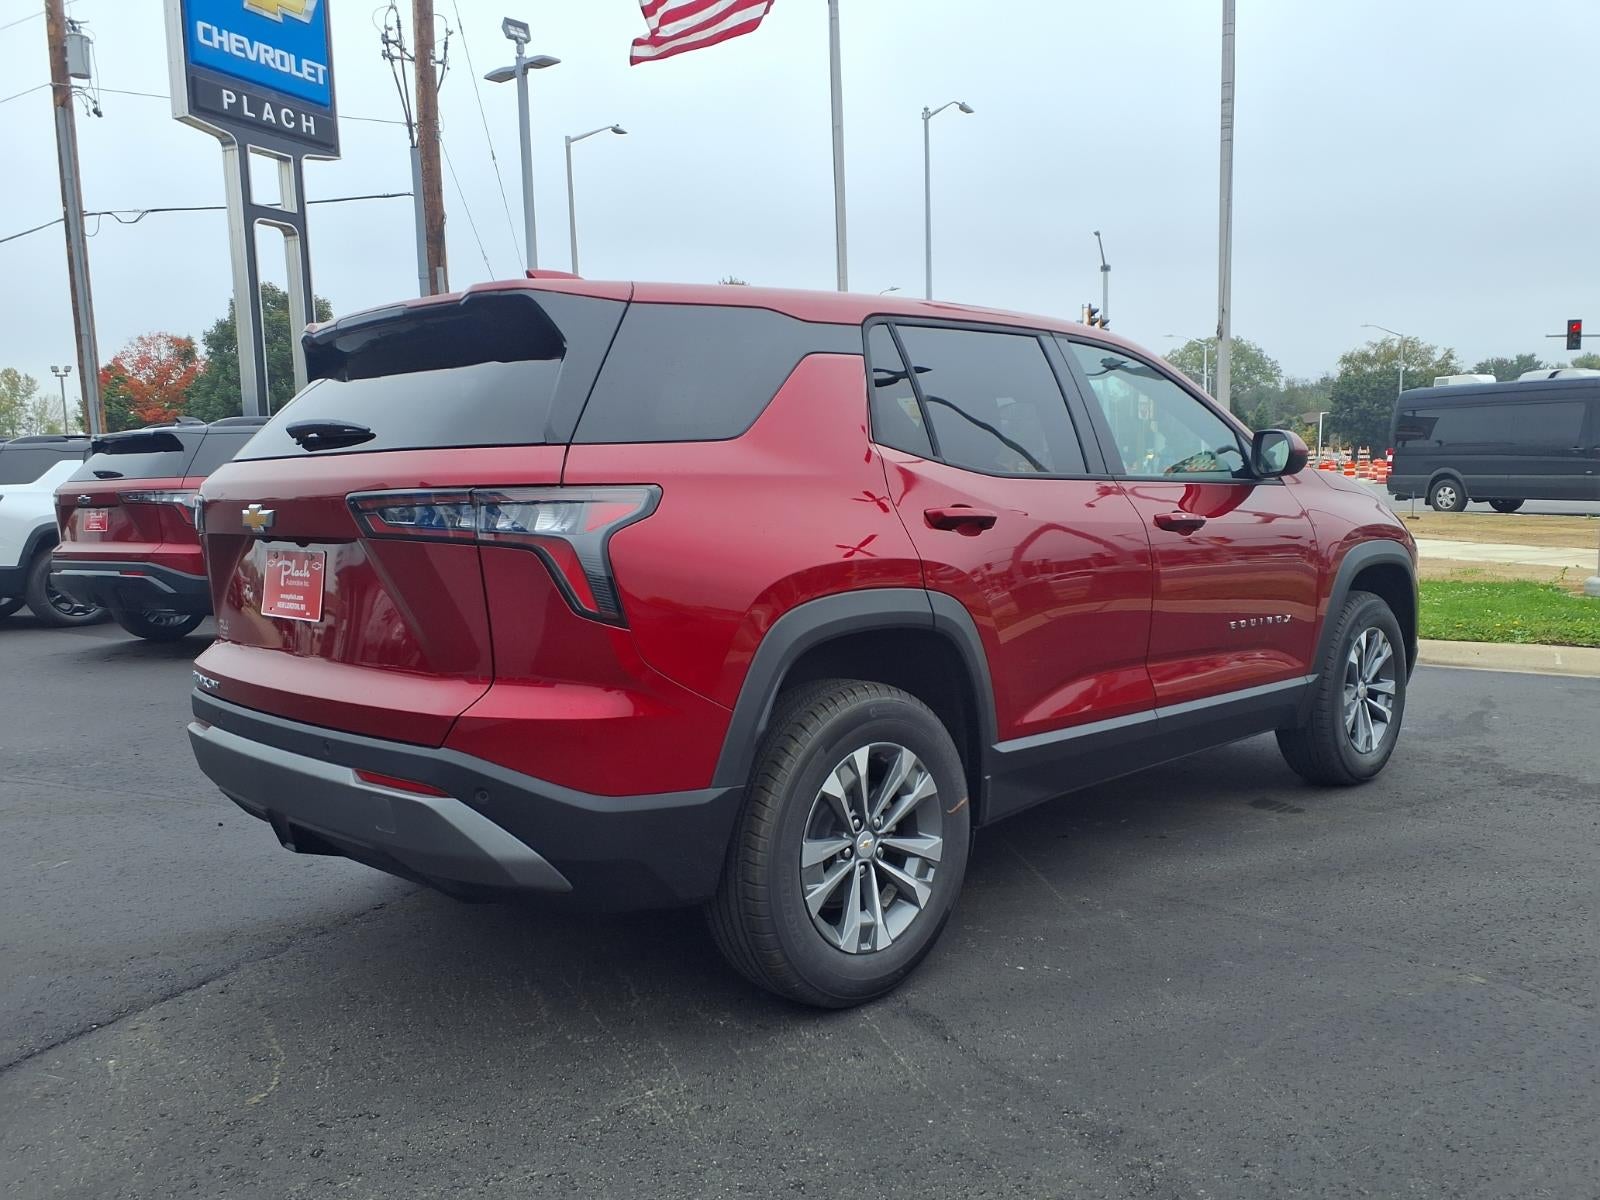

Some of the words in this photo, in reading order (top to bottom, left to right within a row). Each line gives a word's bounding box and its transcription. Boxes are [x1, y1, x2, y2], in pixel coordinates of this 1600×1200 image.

[196, 20, 327, 85] CHEVROLET
[221, 88, 316, 136] PLACH
[277, 555, 310, 587] Plach
[1229, 614, 1291, 629] EQUINOX
